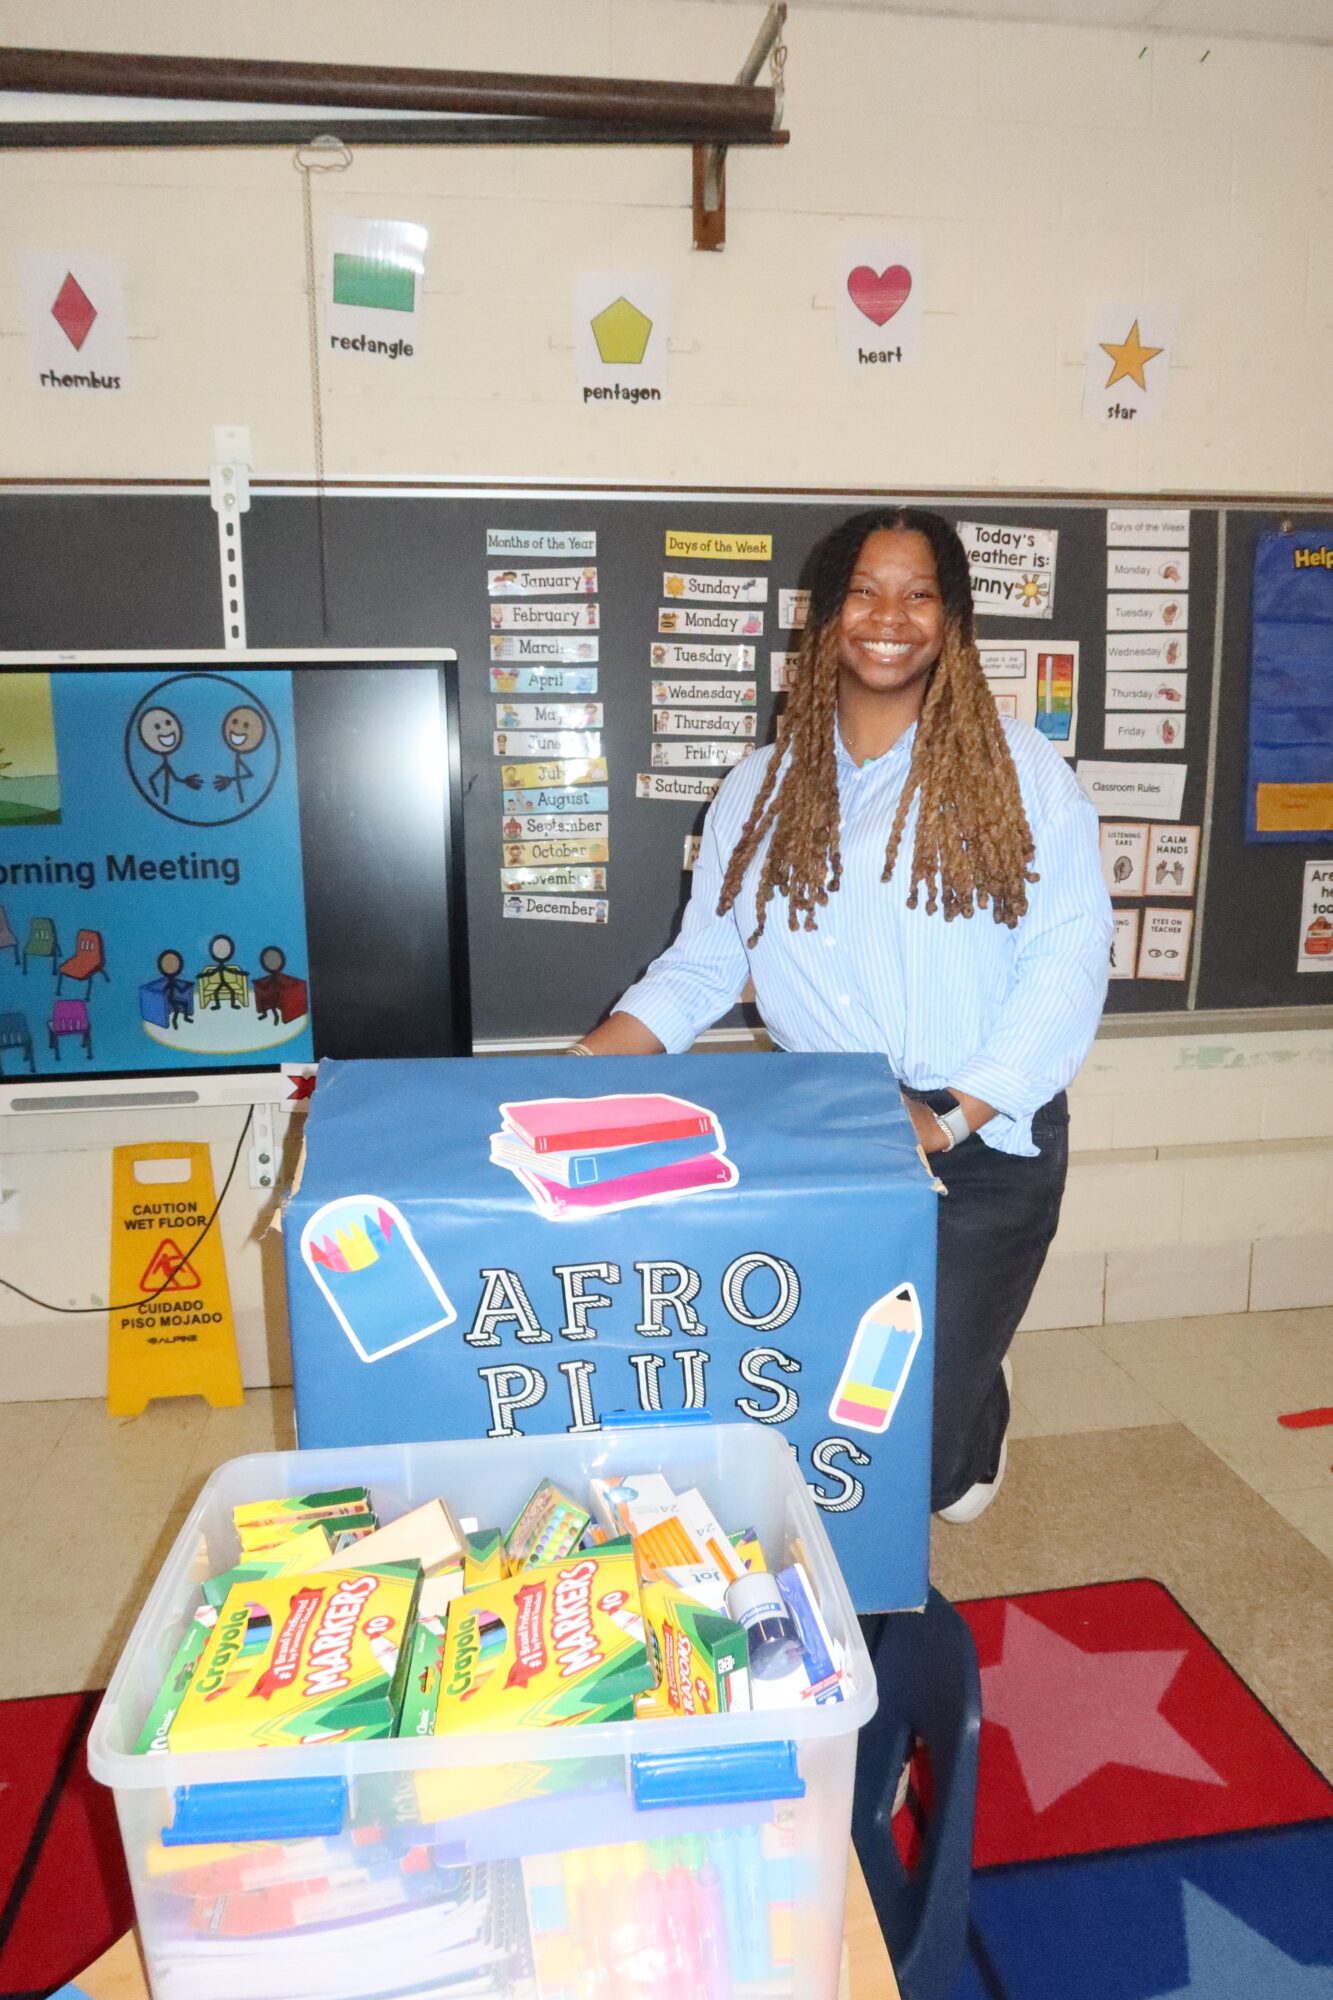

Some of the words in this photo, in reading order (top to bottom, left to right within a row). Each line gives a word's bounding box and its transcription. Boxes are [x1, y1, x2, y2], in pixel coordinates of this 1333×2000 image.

[329, 333, 415, 359] rectangle
[858, 346, 903, 365] heart
[39, 370, 122, 391] rhombus
[582, 383, 662, 404] pentagon
[1107, 403, 1138, 420] star
[1110, 522, 1133, 532] Days
[1134, 522, 1145, 531] of
[1145, 522, 1161, 531] the
[1162, 522, 1185, 532] Week
[488, 535, 529, 549] Months
[532, 536, 545, 549] of
[547, 536, 566, 549] the
[568, 536, 595, 550] Year
[669, 538, 697, 554] Days
[700, 540, 713, 552] of
[715, 540, 733, 552] the
[736, 540, 768, 553] Week
[975, 527, 1035, 548] Today's
[1033, 553, 1050, 568] is:
[1115, 565, 1151, 577] Monday
[520, 572, 581, 592] January
[688, 579, 741, 599] Sunday
[512, 608, 580, 626] February
[685, 612, 739, 632] Monday
[1115, 607, 1153, 619] Tuesday
[674, 646, 732, 667] Tuesday
[1108, 647, 1162, 658] Wednesday
[528, 671, 564, 690] April
[668, 687, 742, 703] Wednesday
[1112, 688, 1154, 700] Thursday
[674, 714, 740, 735] Thursday
[1118, 726, 1146, 738] Friday
[655, 778, 720, 798] Saturday
[1092, 782, 1135, 793] Classroom
[1137, 783, 1161, 793] Rules
[537, 791, 590, 810] August
[527, 819, 602, 837] September
[1107, 832, 1142, 840] LISTENING
[1160, 835, 1187, 845] CALM
[532, 843, 586, 859] October
[1156, 846, 1189, 855] HANDS
[105, 852, 241, 885] Meeting
[526, 898, 596, 916] December
[132, 1202, 198, 1216] CAUTION
[124, 1219, 155, 1231] WET
[158, 1215, 207, 1229] FLOOR
[137, 1300, 204, 1315] CUIDADO
[463, 1251, 801, 1347] AFRO
[121, 1317, 156, 1329] PISO
[160, 1312, 223, 1327] MOJADO
[478, 1347, 802, 1440] PLUS
[602, 1592, 622, 1610] 10
[366, 1616, 390, 1633] 10
[554, 1561, 603, 1677] MARKERS
[305, 1576, 378, 1695] MARKERS
[518, 1630, 531, 1656] Brand
[196, 1608, 249, 1693] Crayola
[274, 1638, 291, 1665] Brand
[447, 1616, 479, 1696] Crayola
[521, 1651, 543, 1668] #1
[273, 1663, 296, 1680] #1
[697, 1680, 707, 1700] 24
